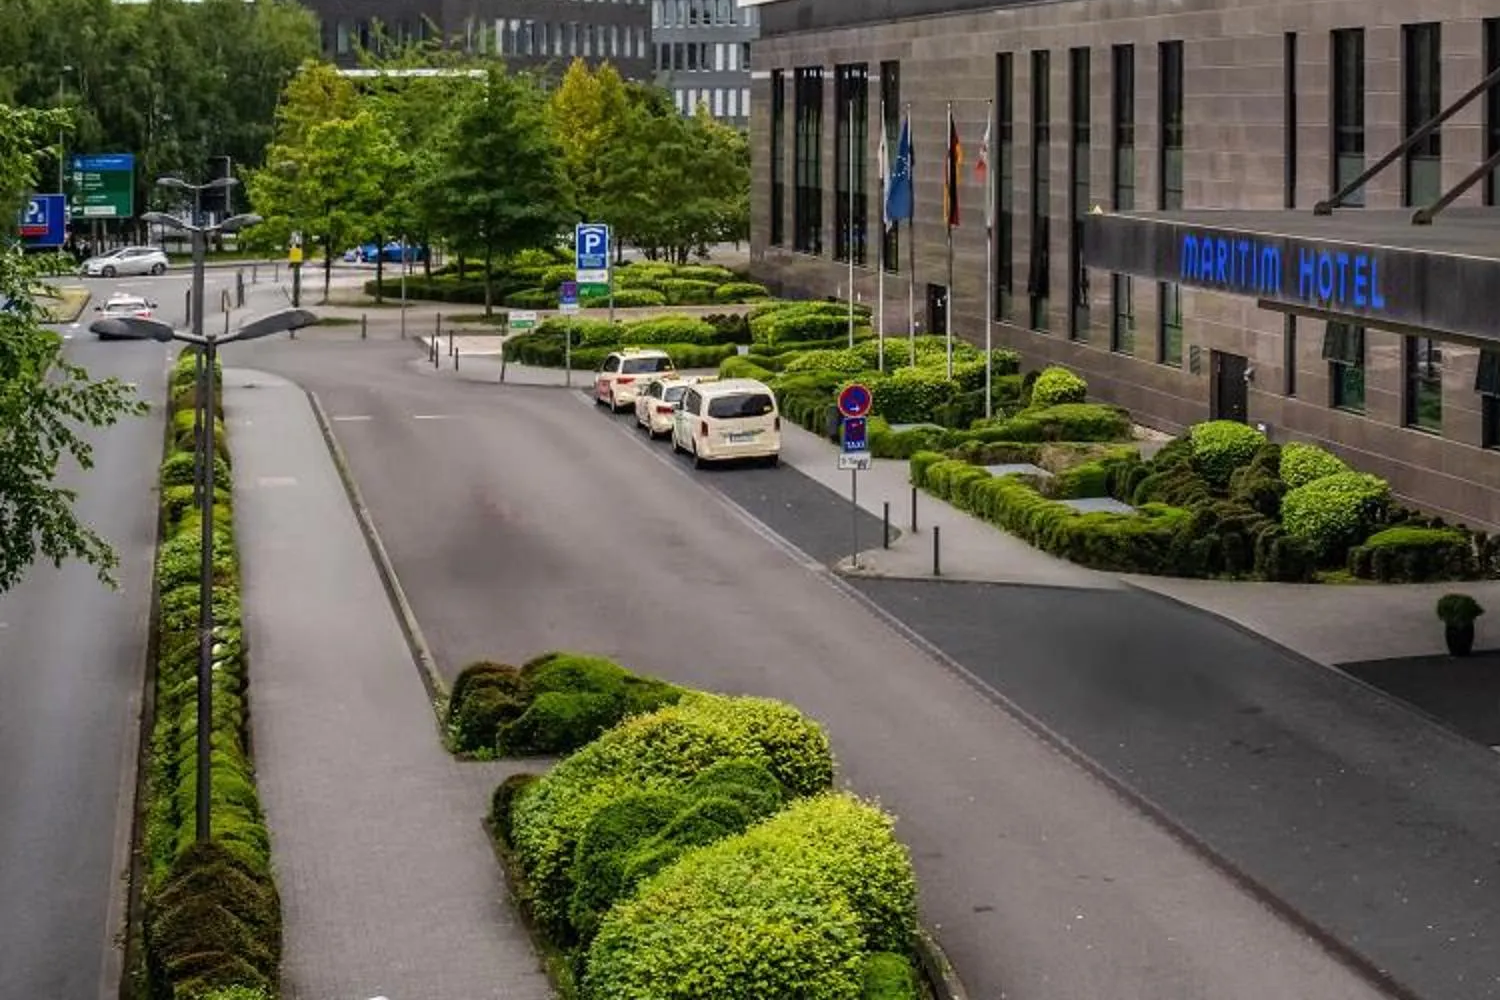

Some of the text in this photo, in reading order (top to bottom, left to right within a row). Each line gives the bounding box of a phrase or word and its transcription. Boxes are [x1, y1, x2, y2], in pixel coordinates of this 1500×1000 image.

[585, 233, 600, 254] P
[1182, 233, 1385, 309] MARITIM HOTEL
